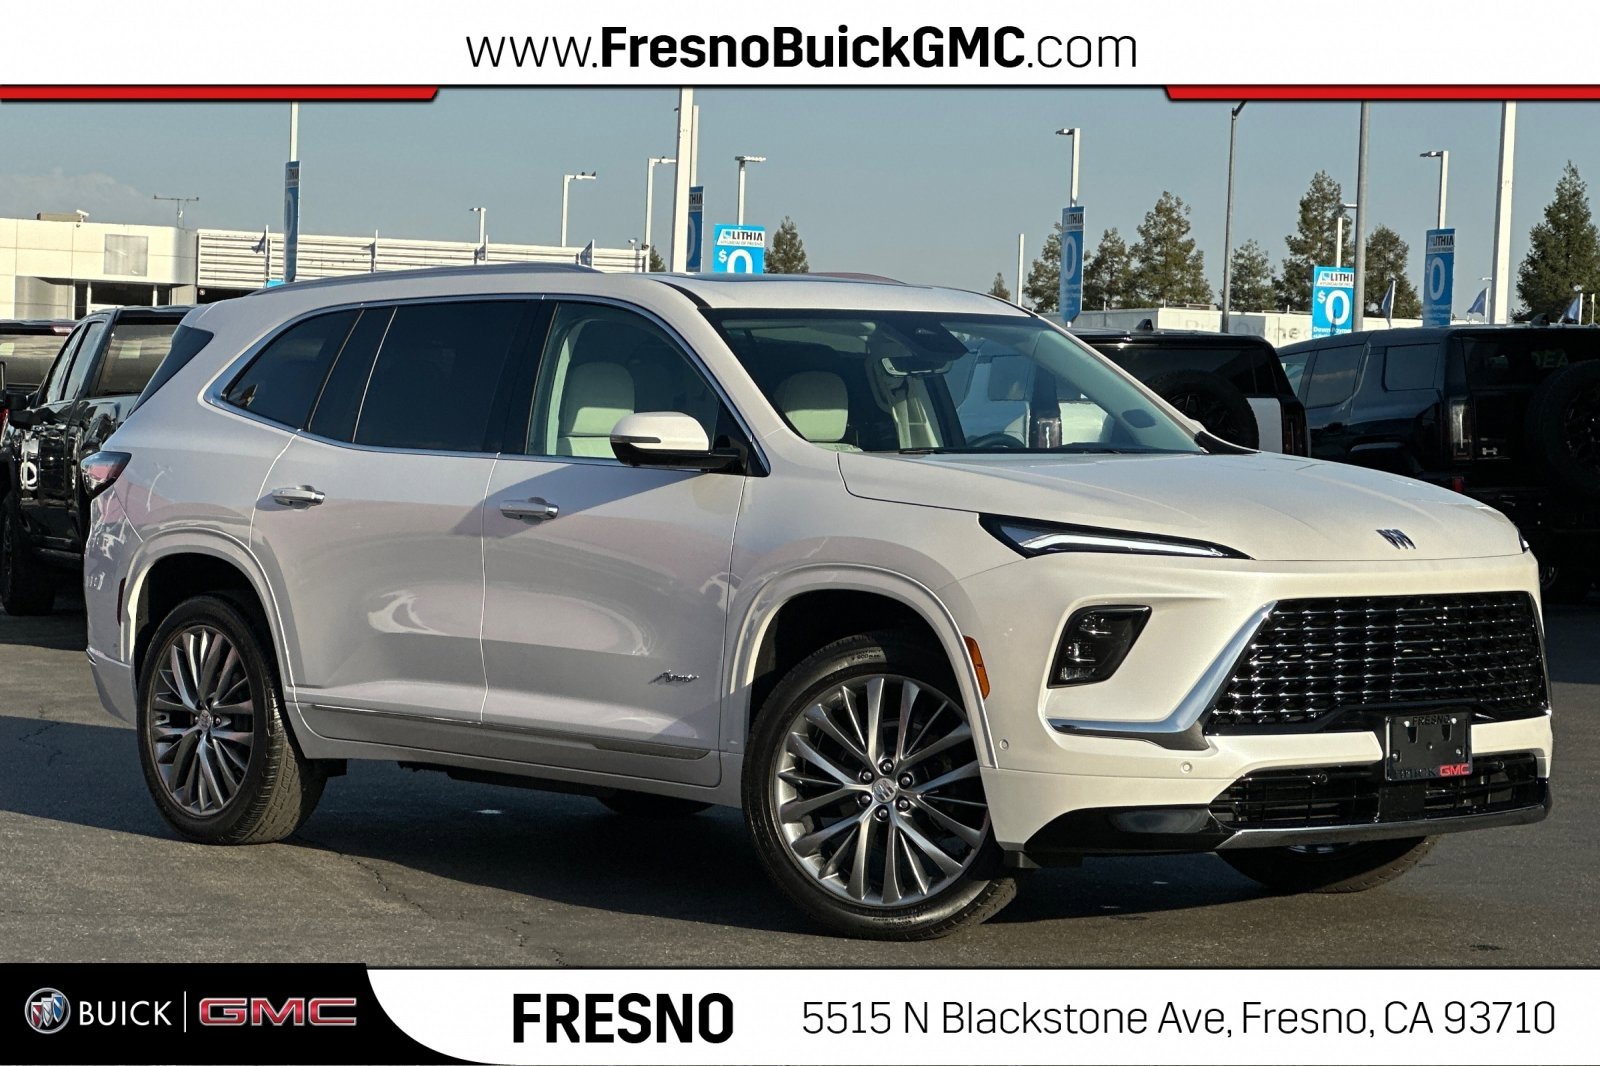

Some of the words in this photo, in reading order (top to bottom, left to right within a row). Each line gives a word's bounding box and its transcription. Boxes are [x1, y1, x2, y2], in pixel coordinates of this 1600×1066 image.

[732, 231, 763, 241] LITHIA
[1330, 272, 1353, 282] LITHI
[1440, 763, 1471, 778] GMC
